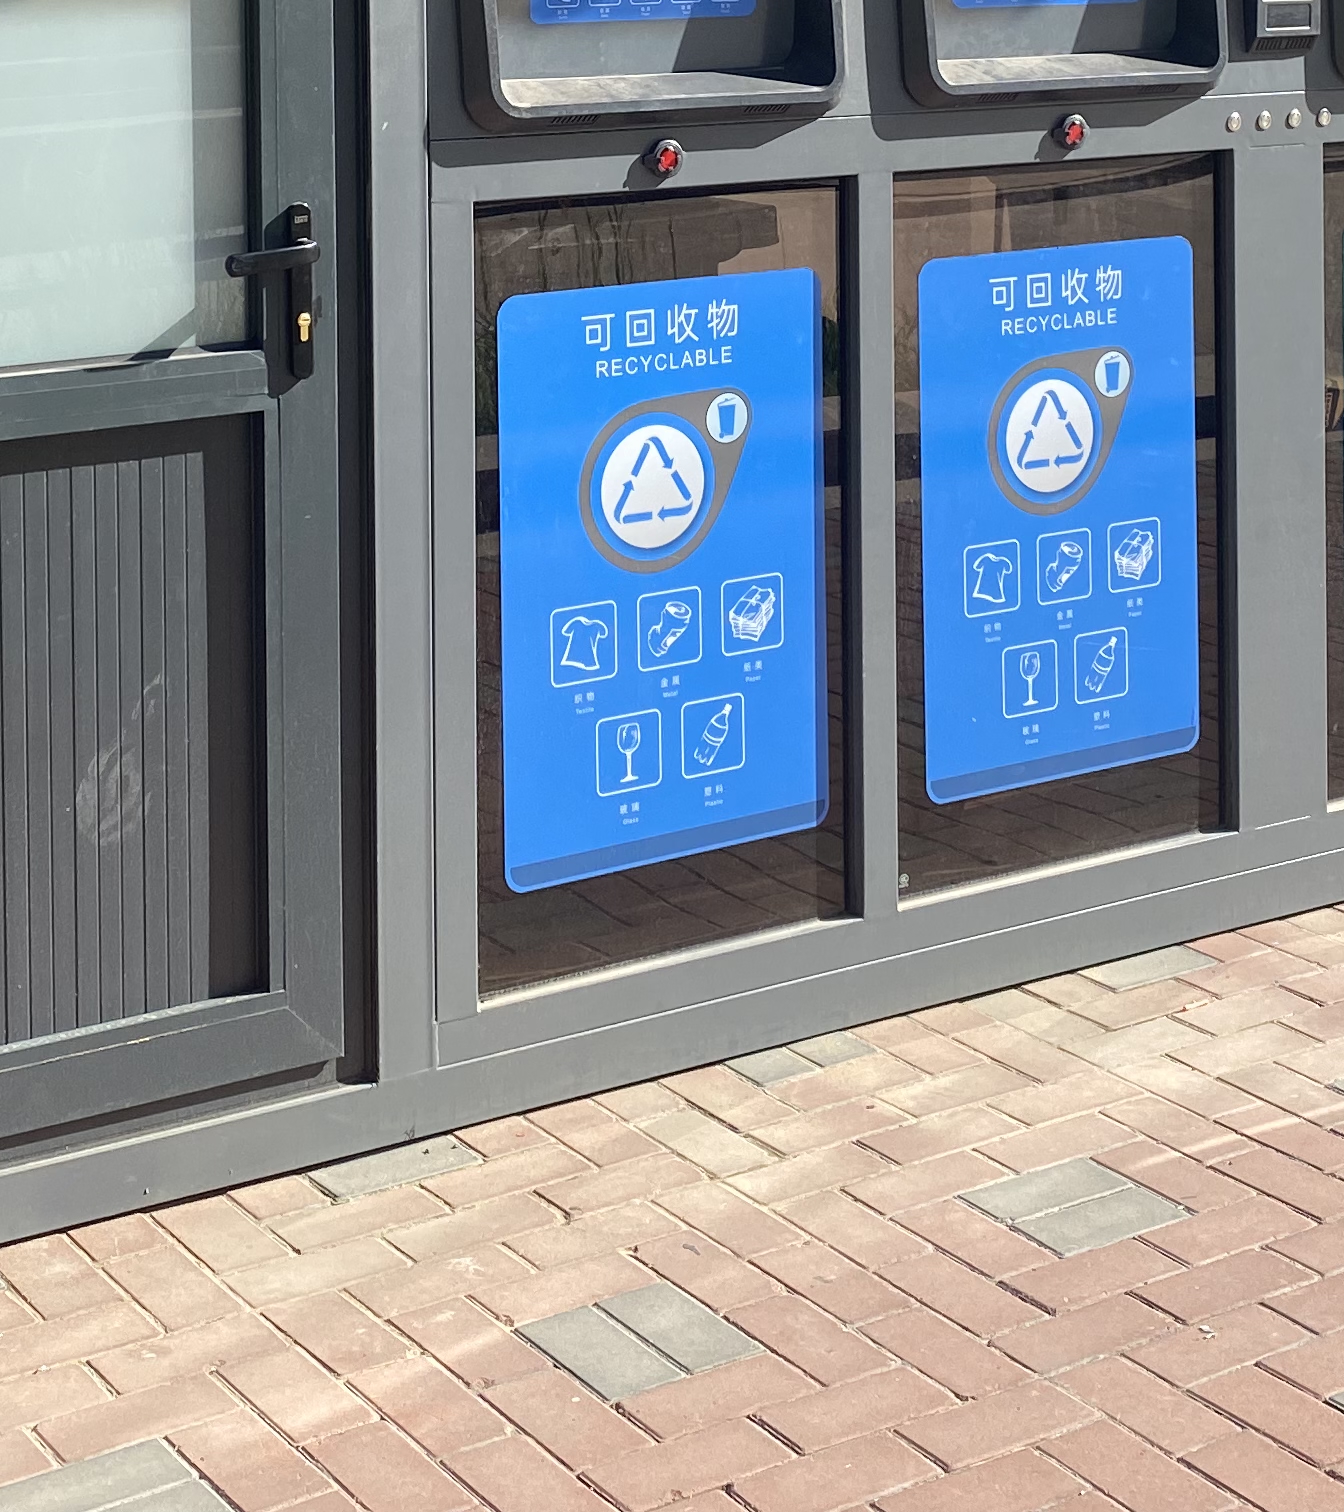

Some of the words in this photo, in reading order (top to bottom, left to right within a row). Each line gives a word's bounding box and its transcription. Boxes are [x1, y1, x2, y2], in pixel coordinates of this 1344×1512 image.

[988, 264, 1123, 312] 可回收物
[580, 298, 739, 352] 可回收物
[1000, 307, 1118, 336] RECYCLABLE
[595, 345, 733, 379] RECYCLABLE
